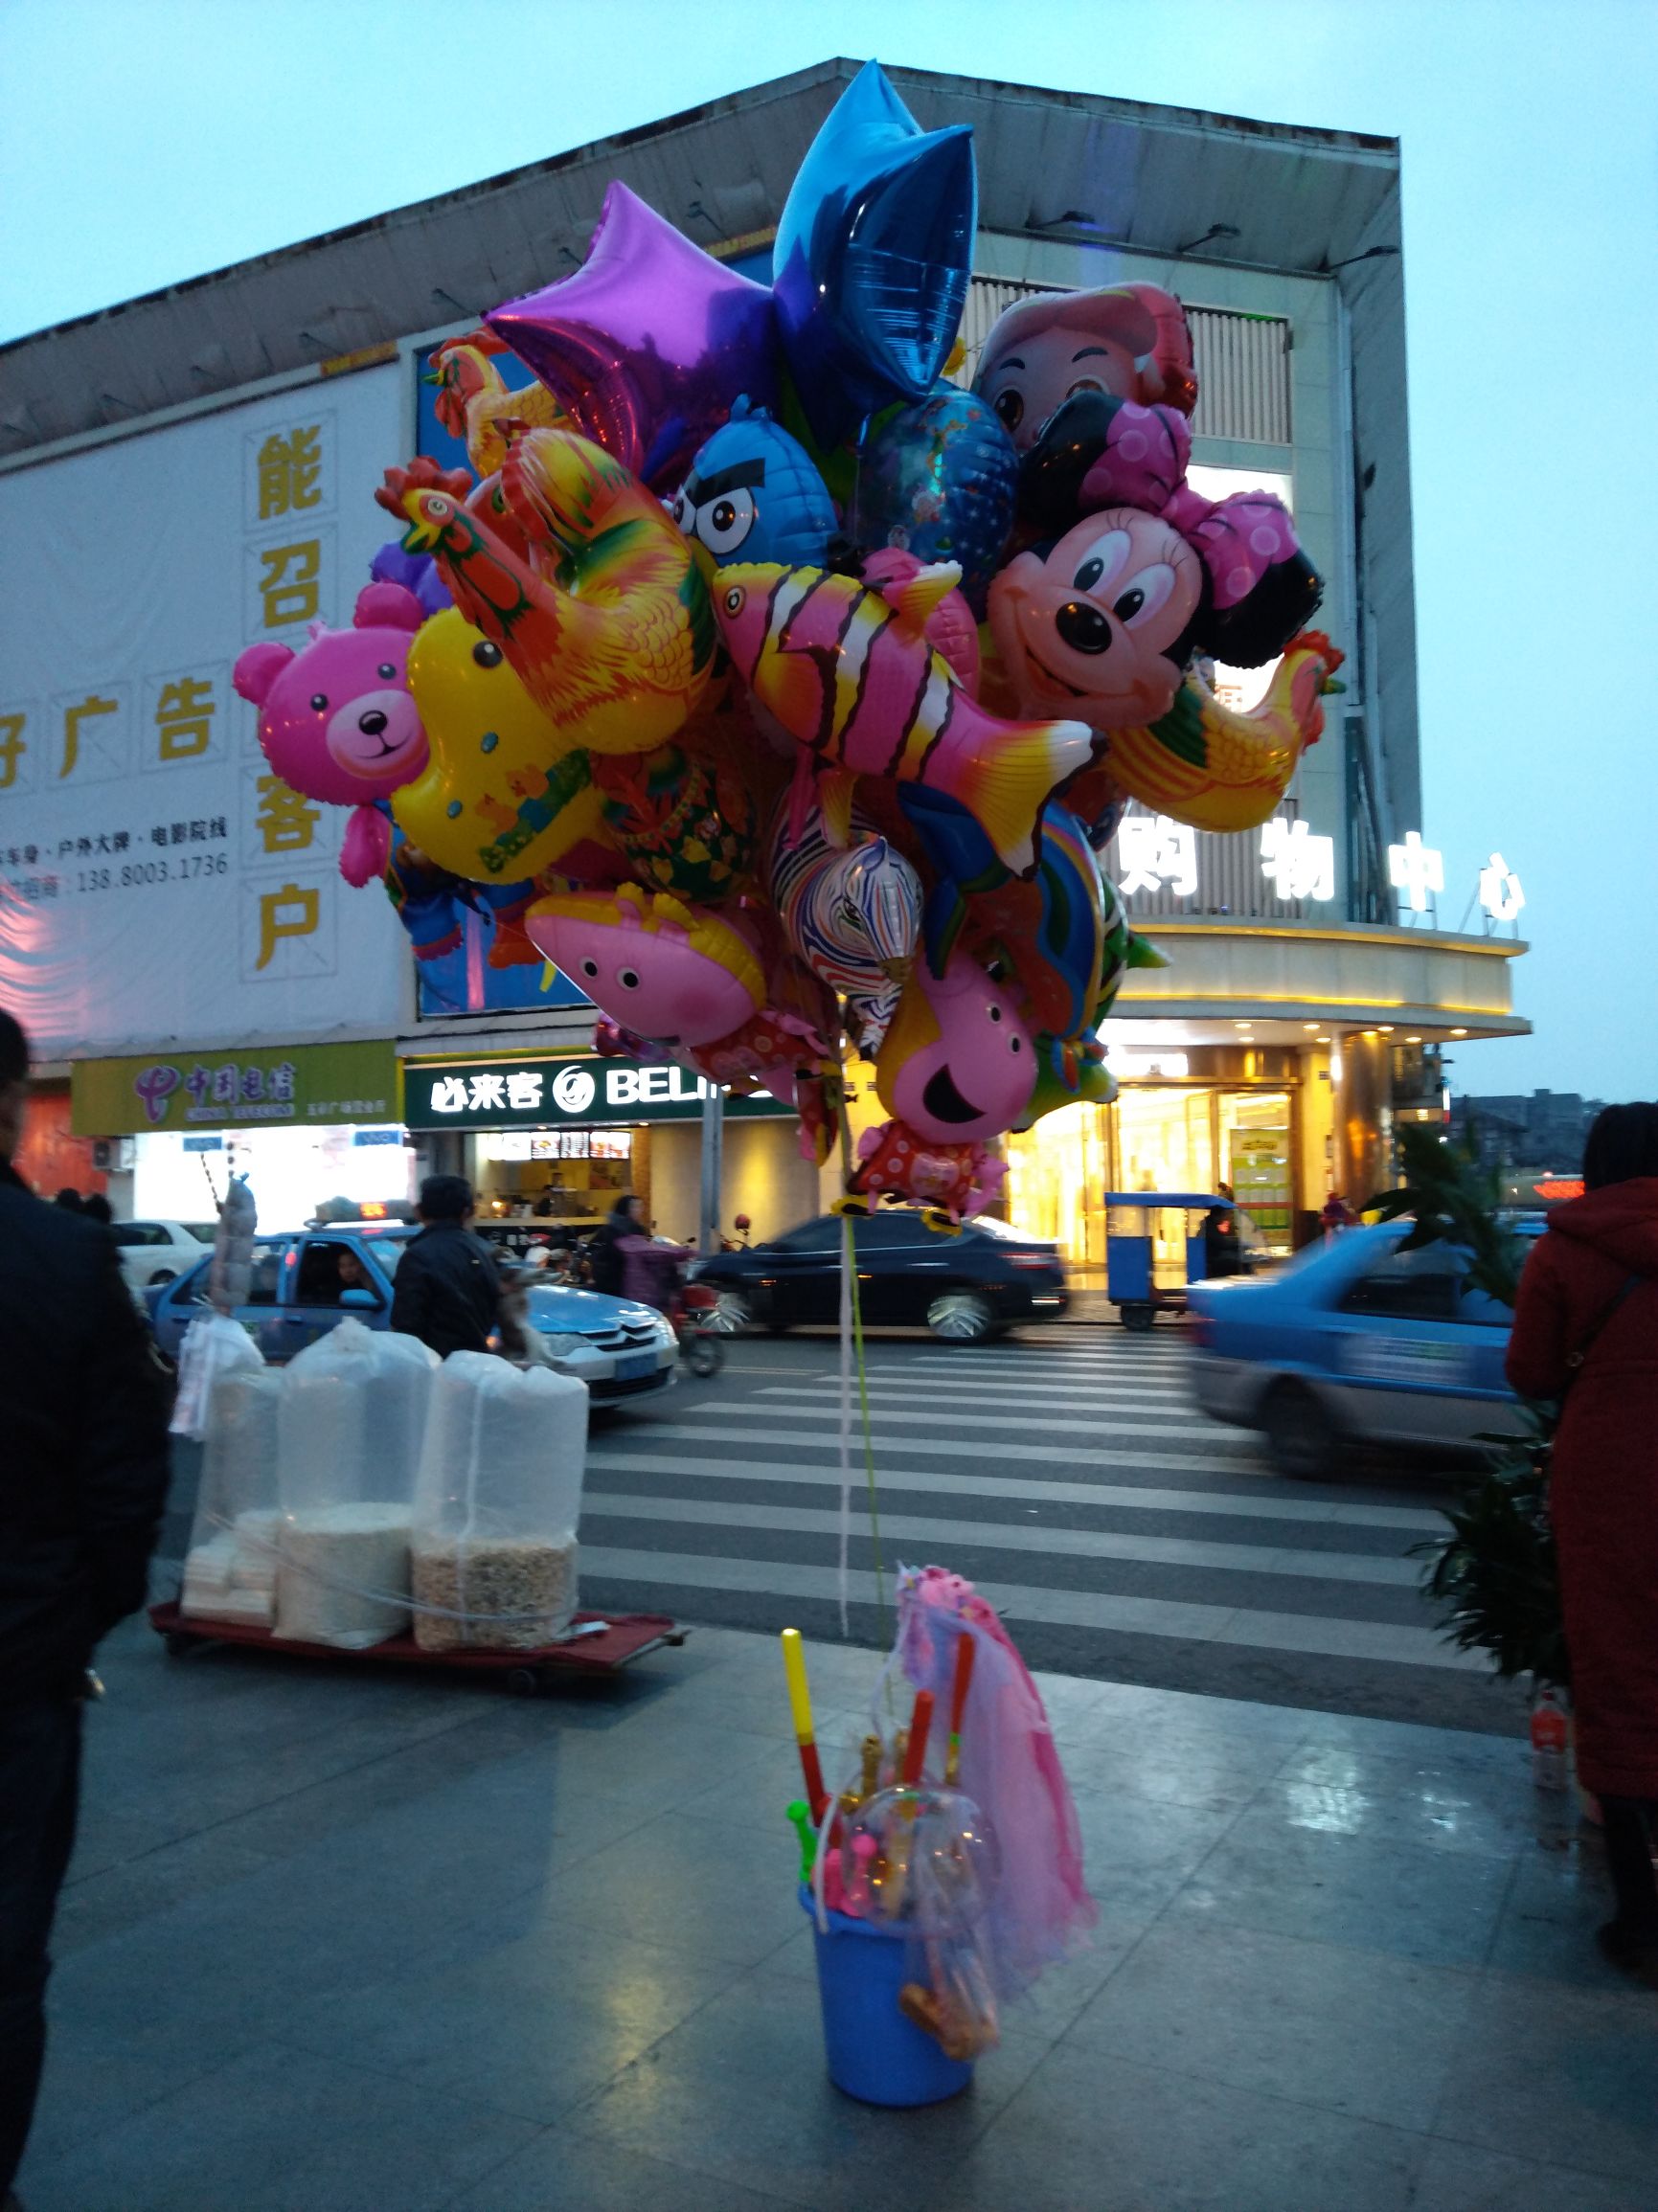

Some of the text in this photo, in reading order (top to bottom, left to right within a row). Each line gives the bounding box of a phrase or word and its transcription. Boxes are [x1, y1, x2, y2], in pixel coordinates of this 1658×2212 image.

[256, 425, 322, 971] 能召客户
[78, 852, 229, 892] 138.8003.1736
[1118, 815, 1525, 920] 购物中心
[185, 1062, 296, 1107] 中国电信
[430, 1072, 543, 1112] 必来客
